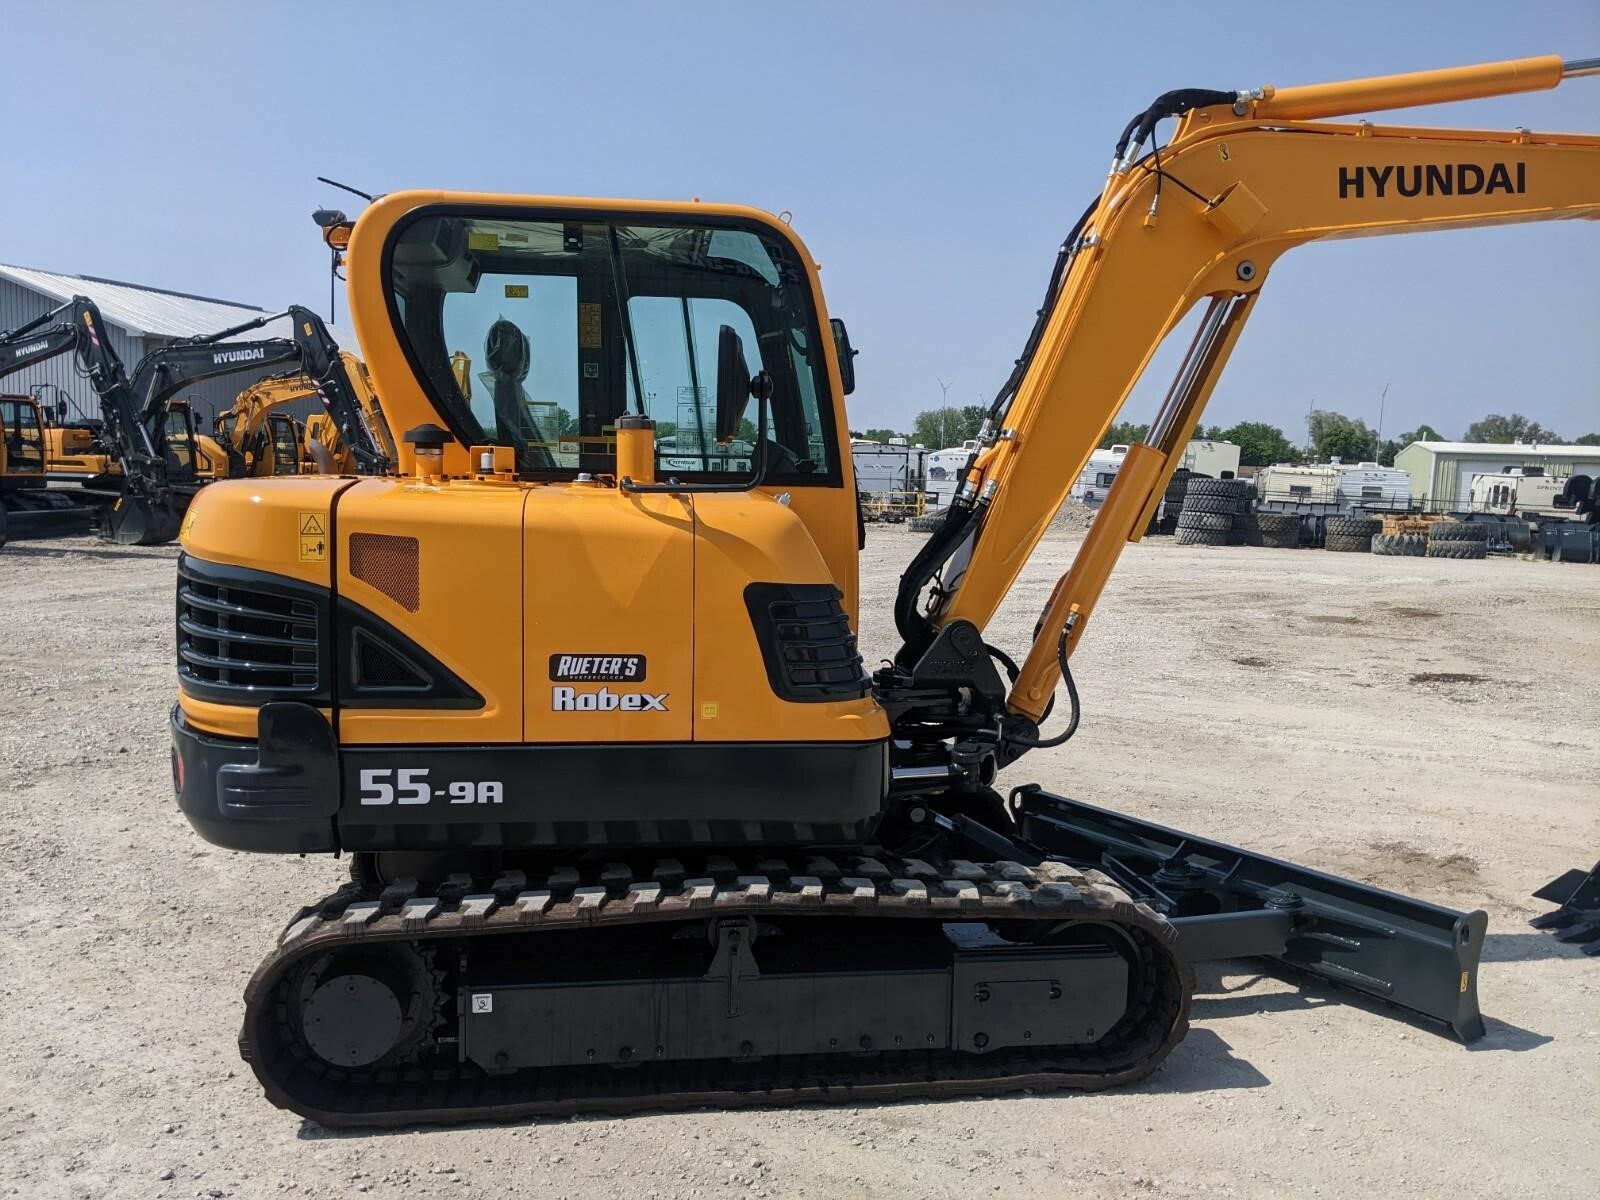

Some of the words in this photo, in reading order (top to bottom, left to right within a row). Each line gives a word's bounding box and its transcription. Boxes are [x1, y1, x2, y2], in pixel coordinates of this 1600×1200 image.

[1338, 162, 1526, 198] HYUNDAI
[15, 340, 48, 357] HYUNDAI
[213, 348, 265, 364] HYUNDAI
[557, 655, 638, 677] RUETER'S
[552, 686, 670, 711] Robex
